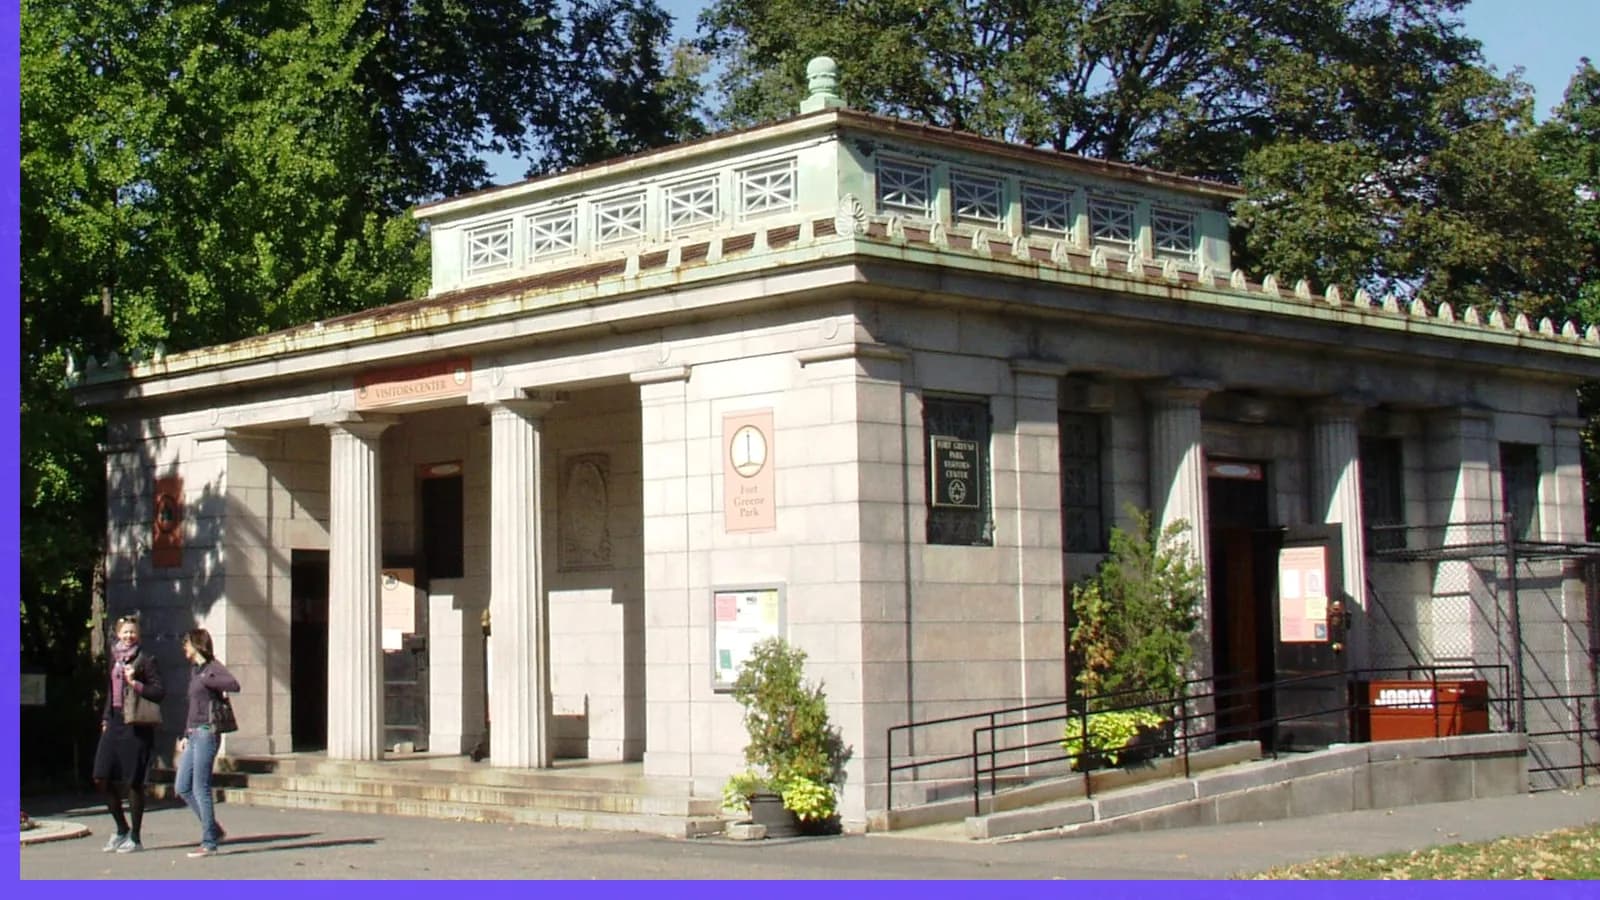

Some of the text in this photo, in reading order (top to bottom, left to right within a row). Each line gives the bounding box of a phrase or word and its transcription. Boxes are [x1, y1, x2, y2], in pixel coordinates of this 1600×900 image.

[375, 380, 446, 399] VISITORS CENTER
[948, 450, 965, 460] PARK
[740, 484, 759, 495] Fort
[733, 497, 765, 507] Greene
[740, 507, 760, 518] Park
